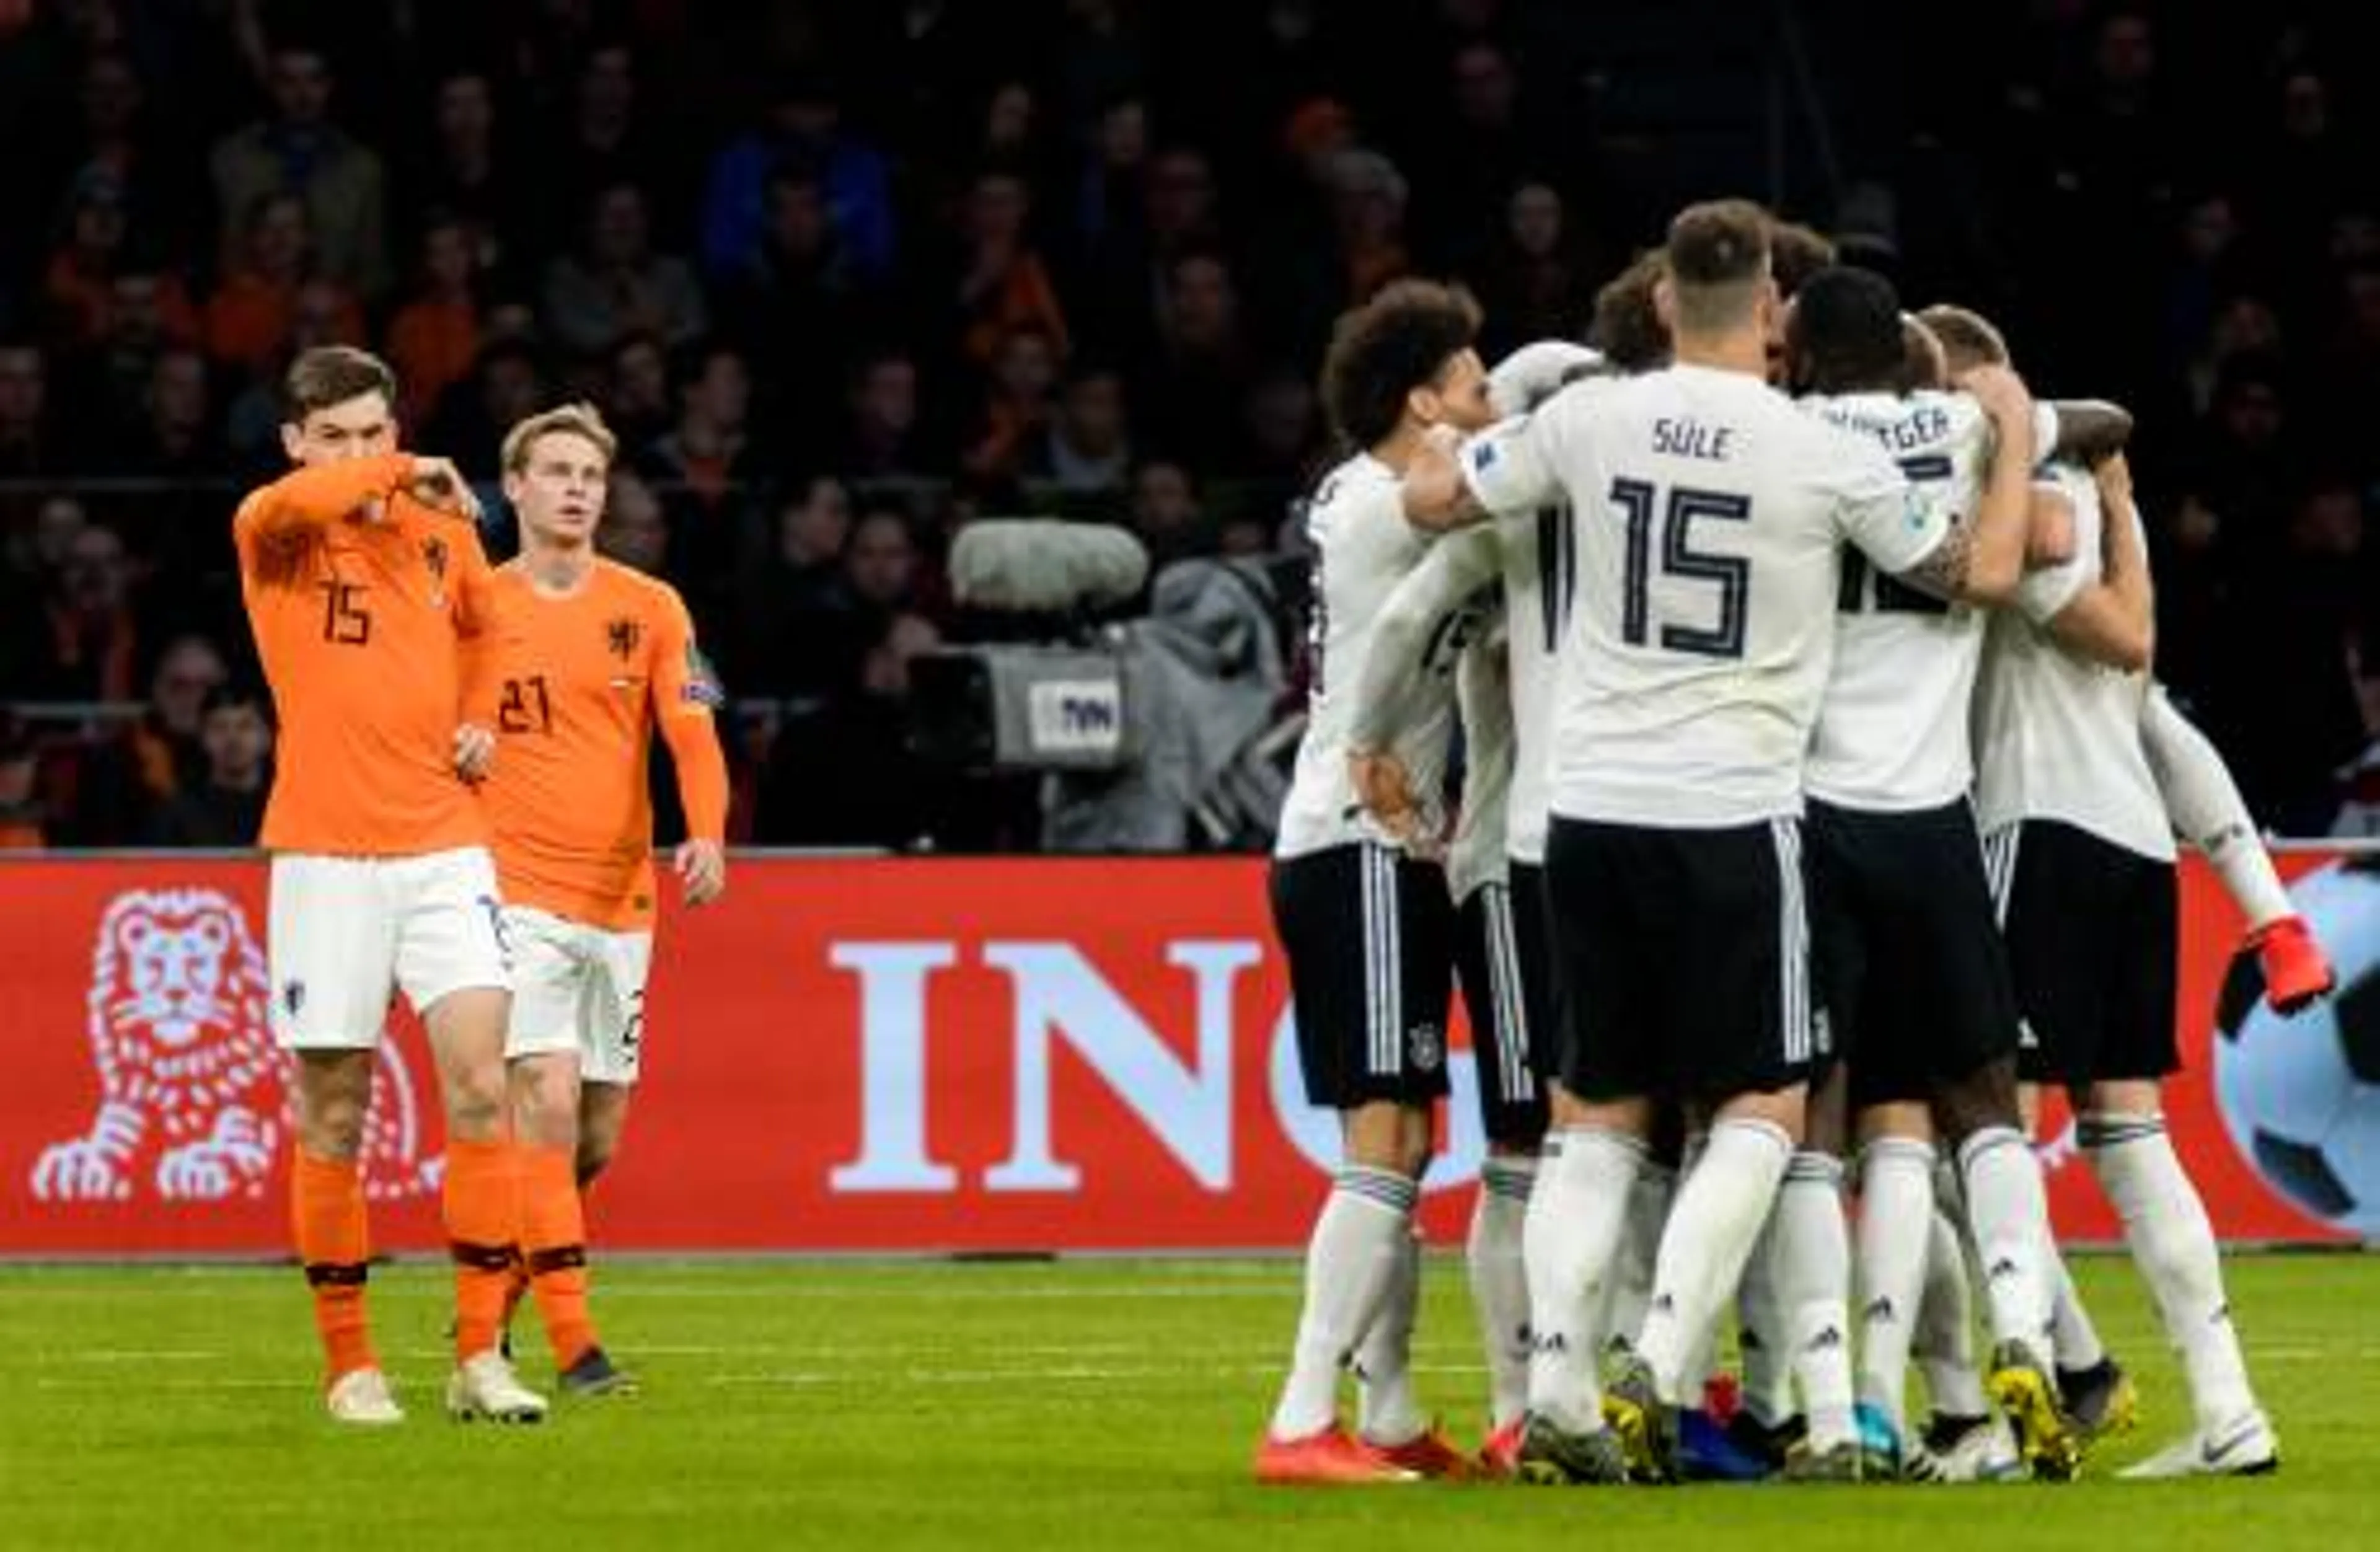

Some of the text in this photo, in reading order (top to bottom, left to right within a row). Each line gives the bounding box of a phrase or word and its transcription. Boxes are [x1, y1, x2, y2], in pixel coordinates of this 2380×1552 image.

[1652, 416, 1734, 462] SÜLE
[1610, 476, 1750, 658] 15
[317, 580, 371, 646] 15
[500, 676, 553, 736] 21
